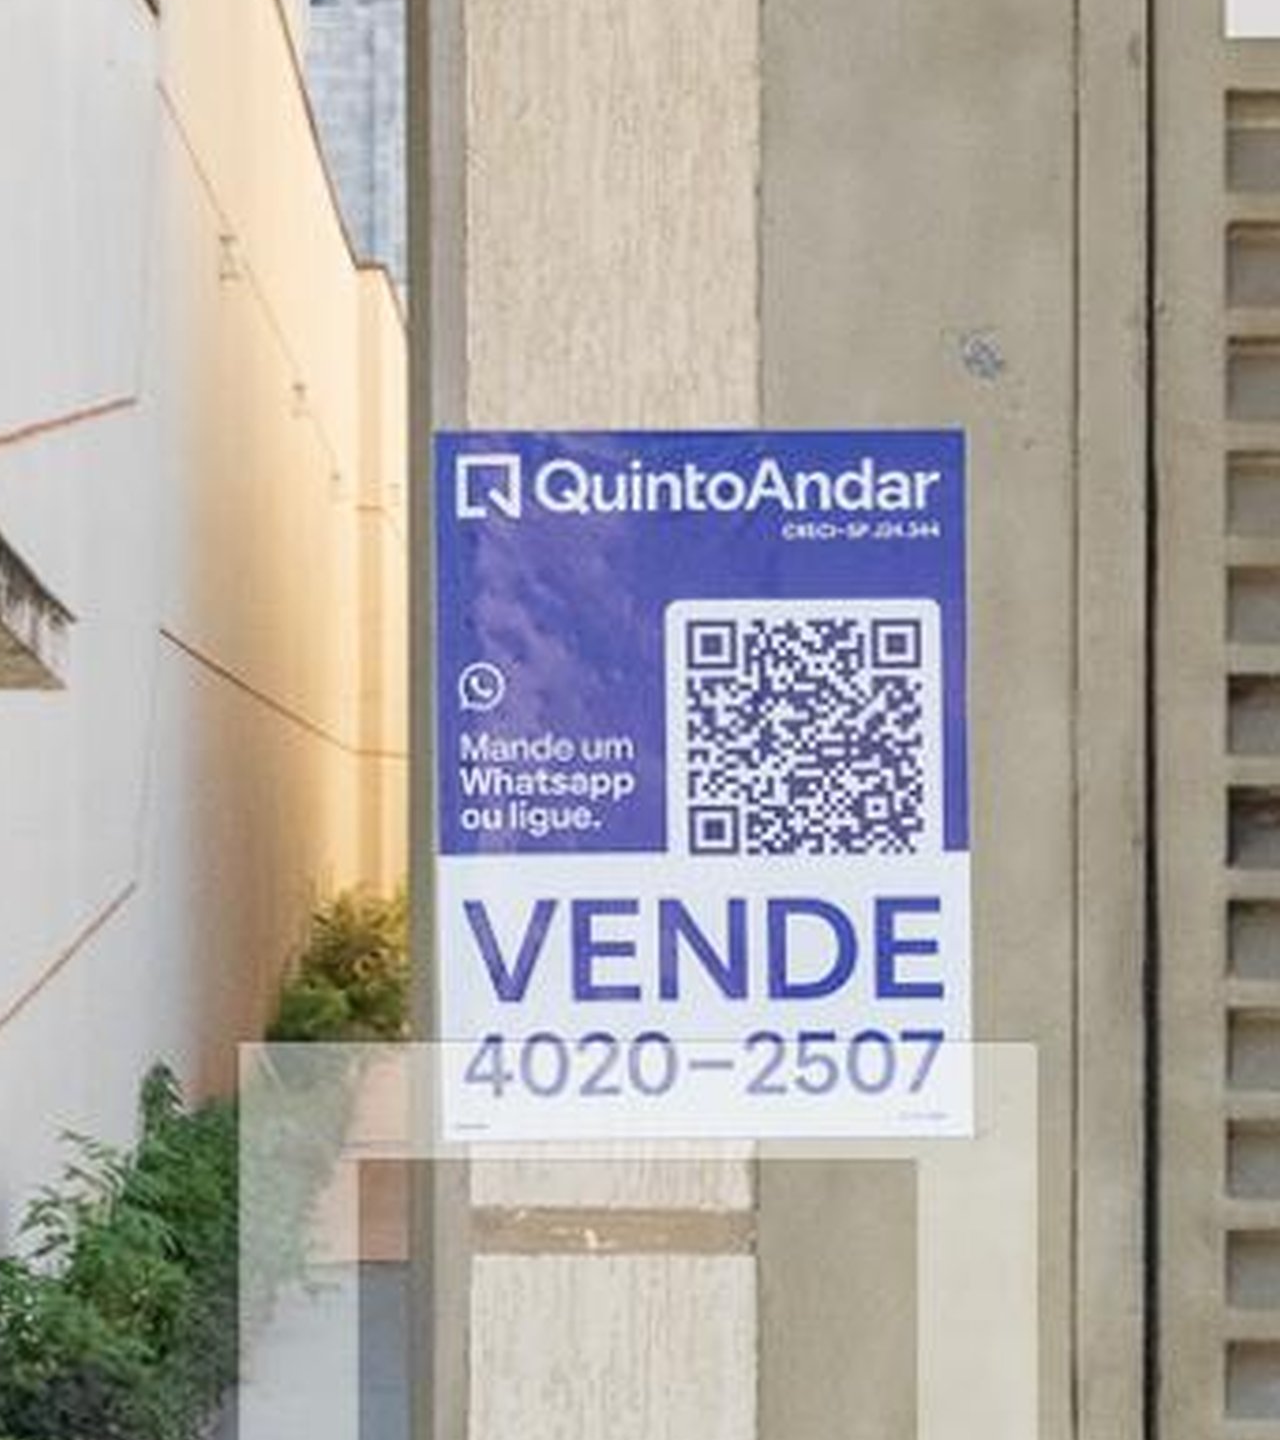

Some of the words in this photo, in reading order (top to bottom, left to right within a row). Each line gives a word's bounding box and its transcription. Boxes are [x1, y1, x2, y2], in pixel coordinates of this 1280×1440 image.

[534, 458, 941, 514] QuintoAndar
[459, 732, 576, 762] Mande
[580, 736, 635, 762] um
[459, 766, 636, 801] Whatsapp
[461, 807, 503, 830] ou
[509, 799, 603, 838] ligue.
[462, 895, 945, 1003] VENDE
[463, 1028, 945, 1098] 4020-2507
